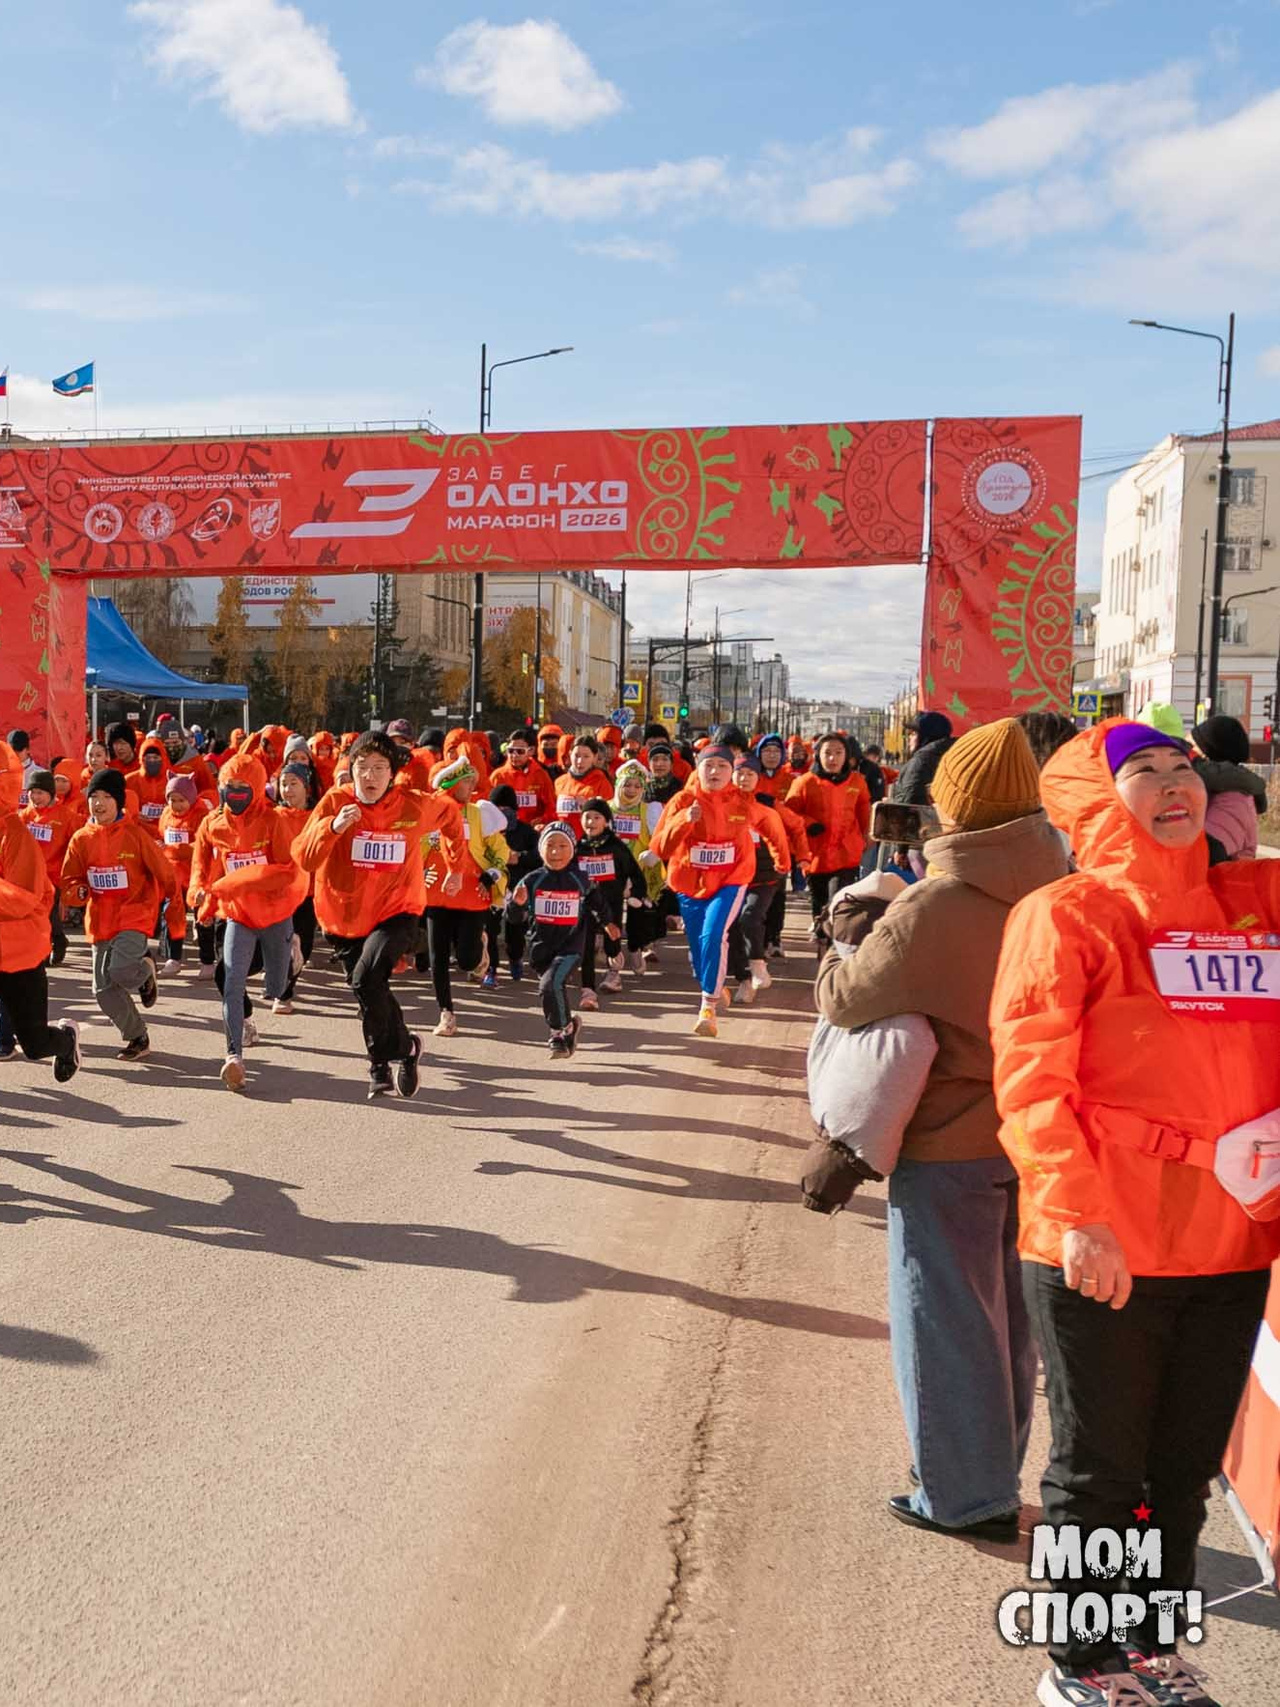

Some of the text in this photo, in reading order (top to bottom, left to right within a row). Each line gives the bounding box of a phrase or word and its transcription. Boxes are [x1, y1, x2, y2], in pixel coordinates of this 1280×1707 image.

[78, 476, 155, 485] МИНИСТЕРСТВО
[241, 472, 292, 481] КУЛЬТУРЕ
[447, 464, 567, 482] ЗАБЕГ
[205, 481, 231, 490] САХА
[447, 480, 629, 508] ОЛОНХО
[447, 513, 622, 530] МАРАФОН 2026
[363, 841, 395, 861] 0011
[700, 850, 726, 864] 0026
[544, 900, 571, 916] 0035
[1185, 954, 1269, 993] 1472
[1170, 1000, 1226, 1012] ЯКУТСК
